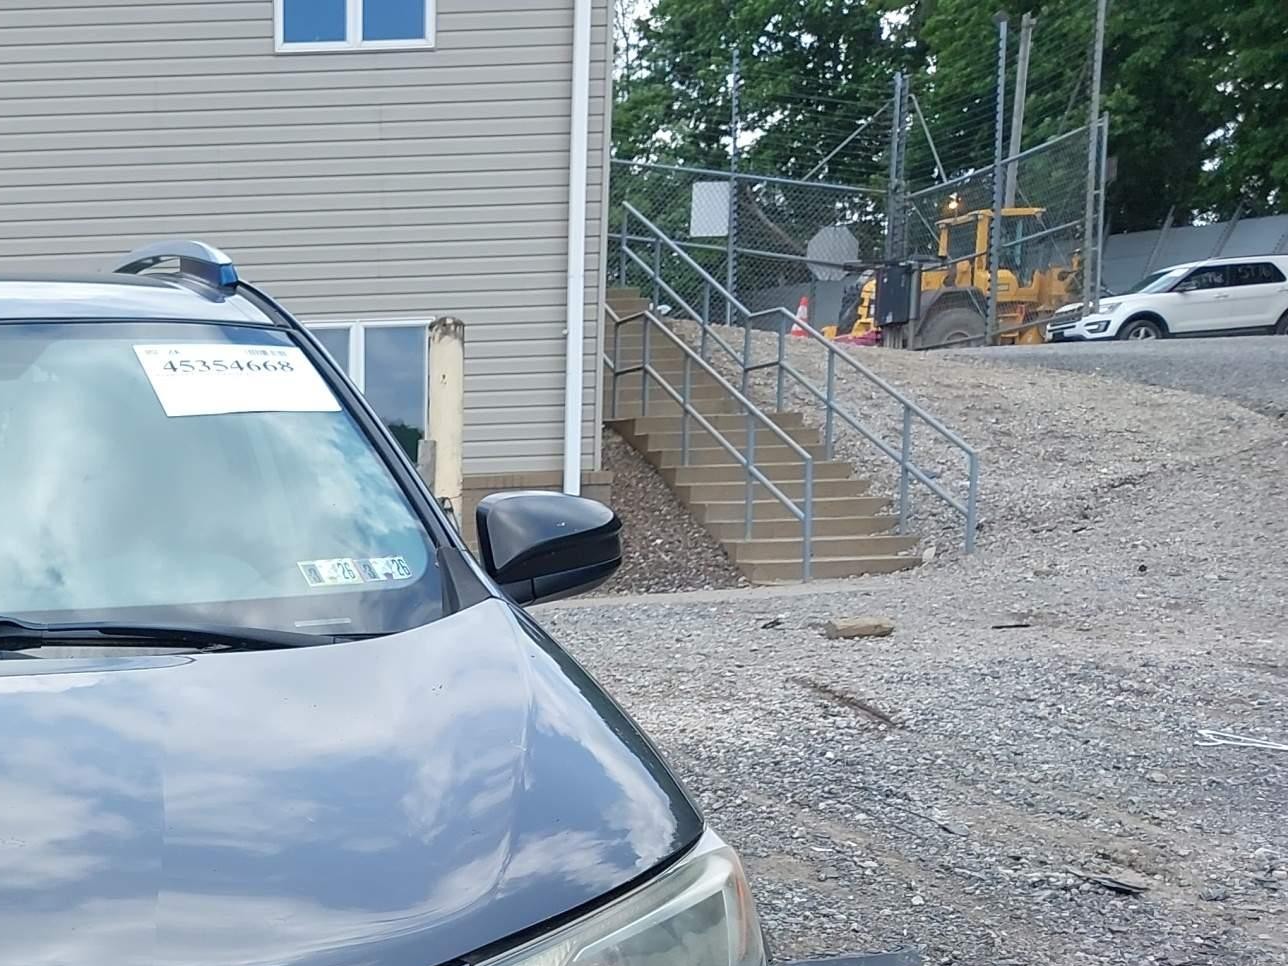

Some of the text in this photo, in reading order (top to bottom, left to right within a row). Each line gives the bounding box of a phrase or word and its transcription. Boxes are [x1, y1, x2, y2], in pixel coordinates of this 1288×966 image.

[163, 359, 295, 373] 45354668
[336, 561, 357, 580] 26
[391, 558, 412, 576] 26
